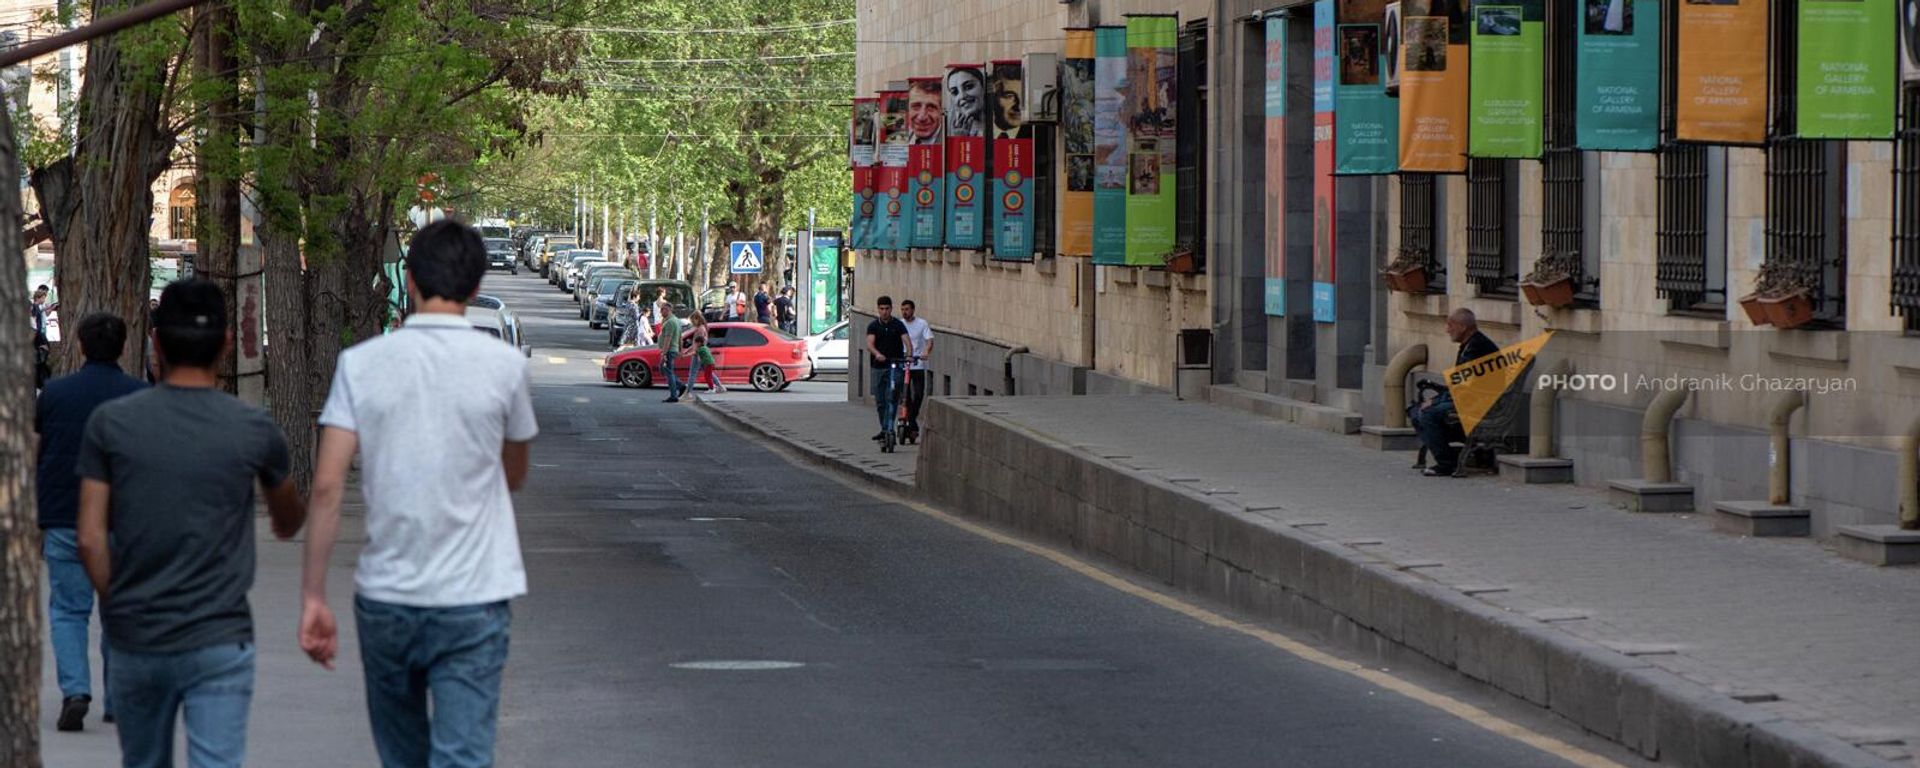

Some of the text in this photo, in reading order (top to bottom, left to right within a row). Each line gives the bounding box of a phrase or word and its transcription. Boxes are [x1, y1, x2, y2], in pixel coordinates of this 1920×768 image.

[1820, 62, 1870, 72] NATIONAL
[1699, 75, 1743, 85] NATIONAL
[1823, 73, 1867, 83] GALLERY
[1597, 86, 1637, 94] NATIONAL
[1702, 86, 1741, 95] GALLERY
[1815, 85, 1876, 95] OF ARMENIA
[1600, 95, 1634, 104] GALLERY
[1694, 96, 1749, 105] OF ARMENIA
[1592, 105, 1642, 114] OF ARMENIA
